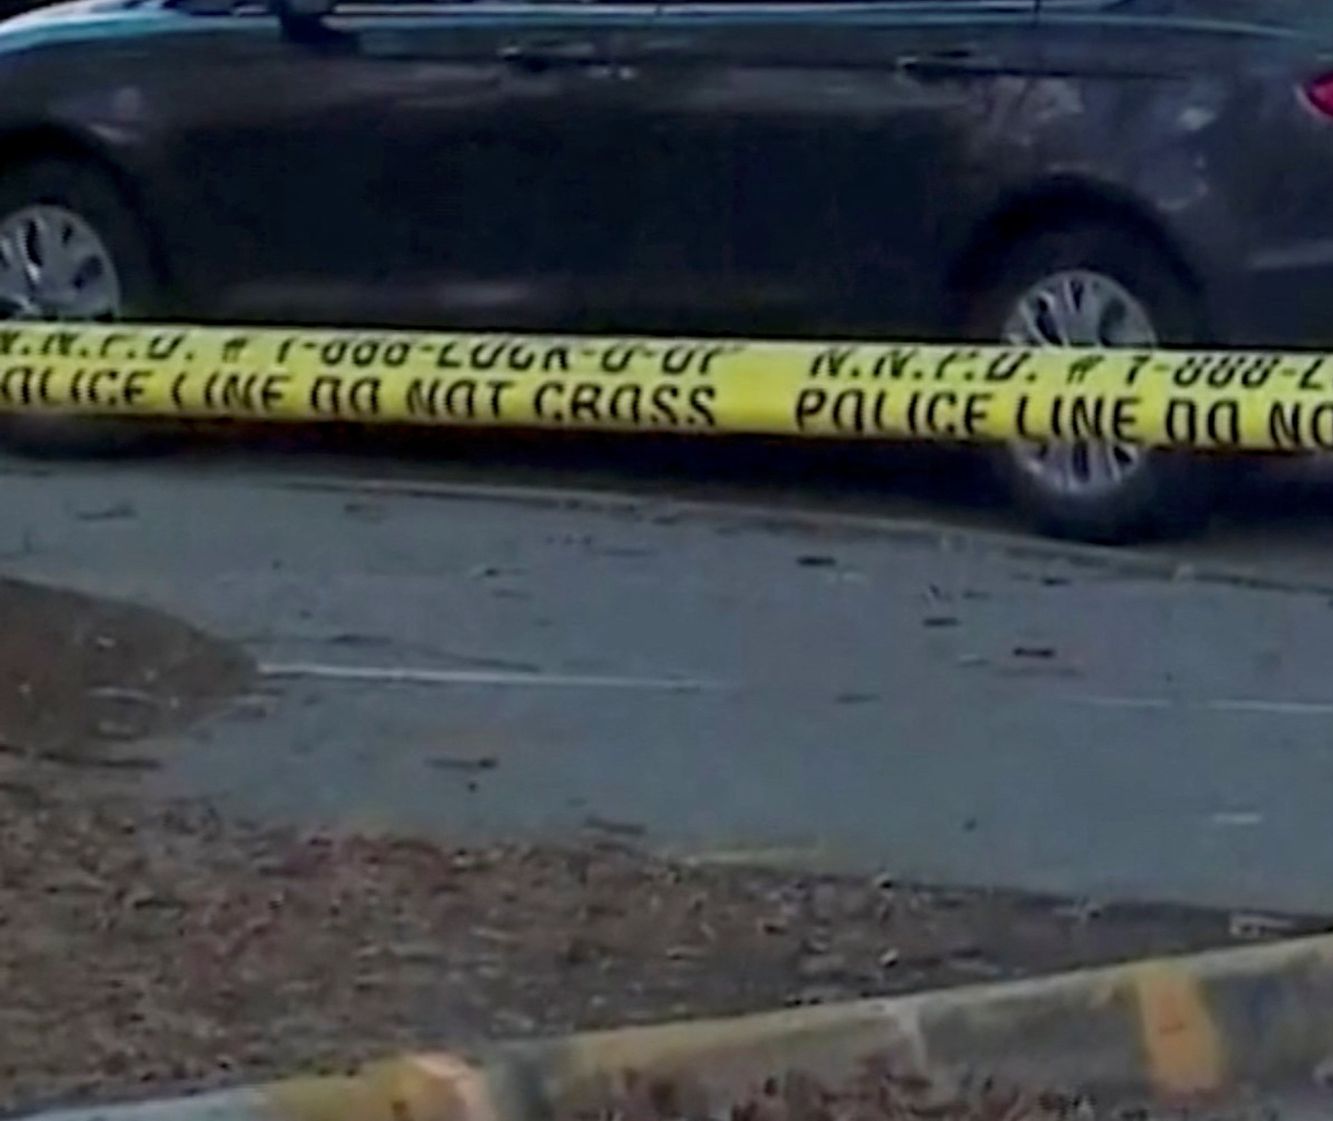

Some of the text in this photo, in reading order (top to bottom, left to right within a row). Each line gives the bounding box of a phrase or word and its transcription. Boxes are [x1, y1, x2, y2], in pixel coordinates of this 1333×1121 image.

[1067, 355, 1104, 386] #
[172, 371, 291, 413] LINE
[311, 376, 380, 417] DO
[406, 378, 514, 420] NOT
[535, 382, 716, 427] CROSS
[795, 387, 994, 435] POLICE
[1015, 393, 1143, 444] LINE
[1165, 397, 1240, 448] DO
